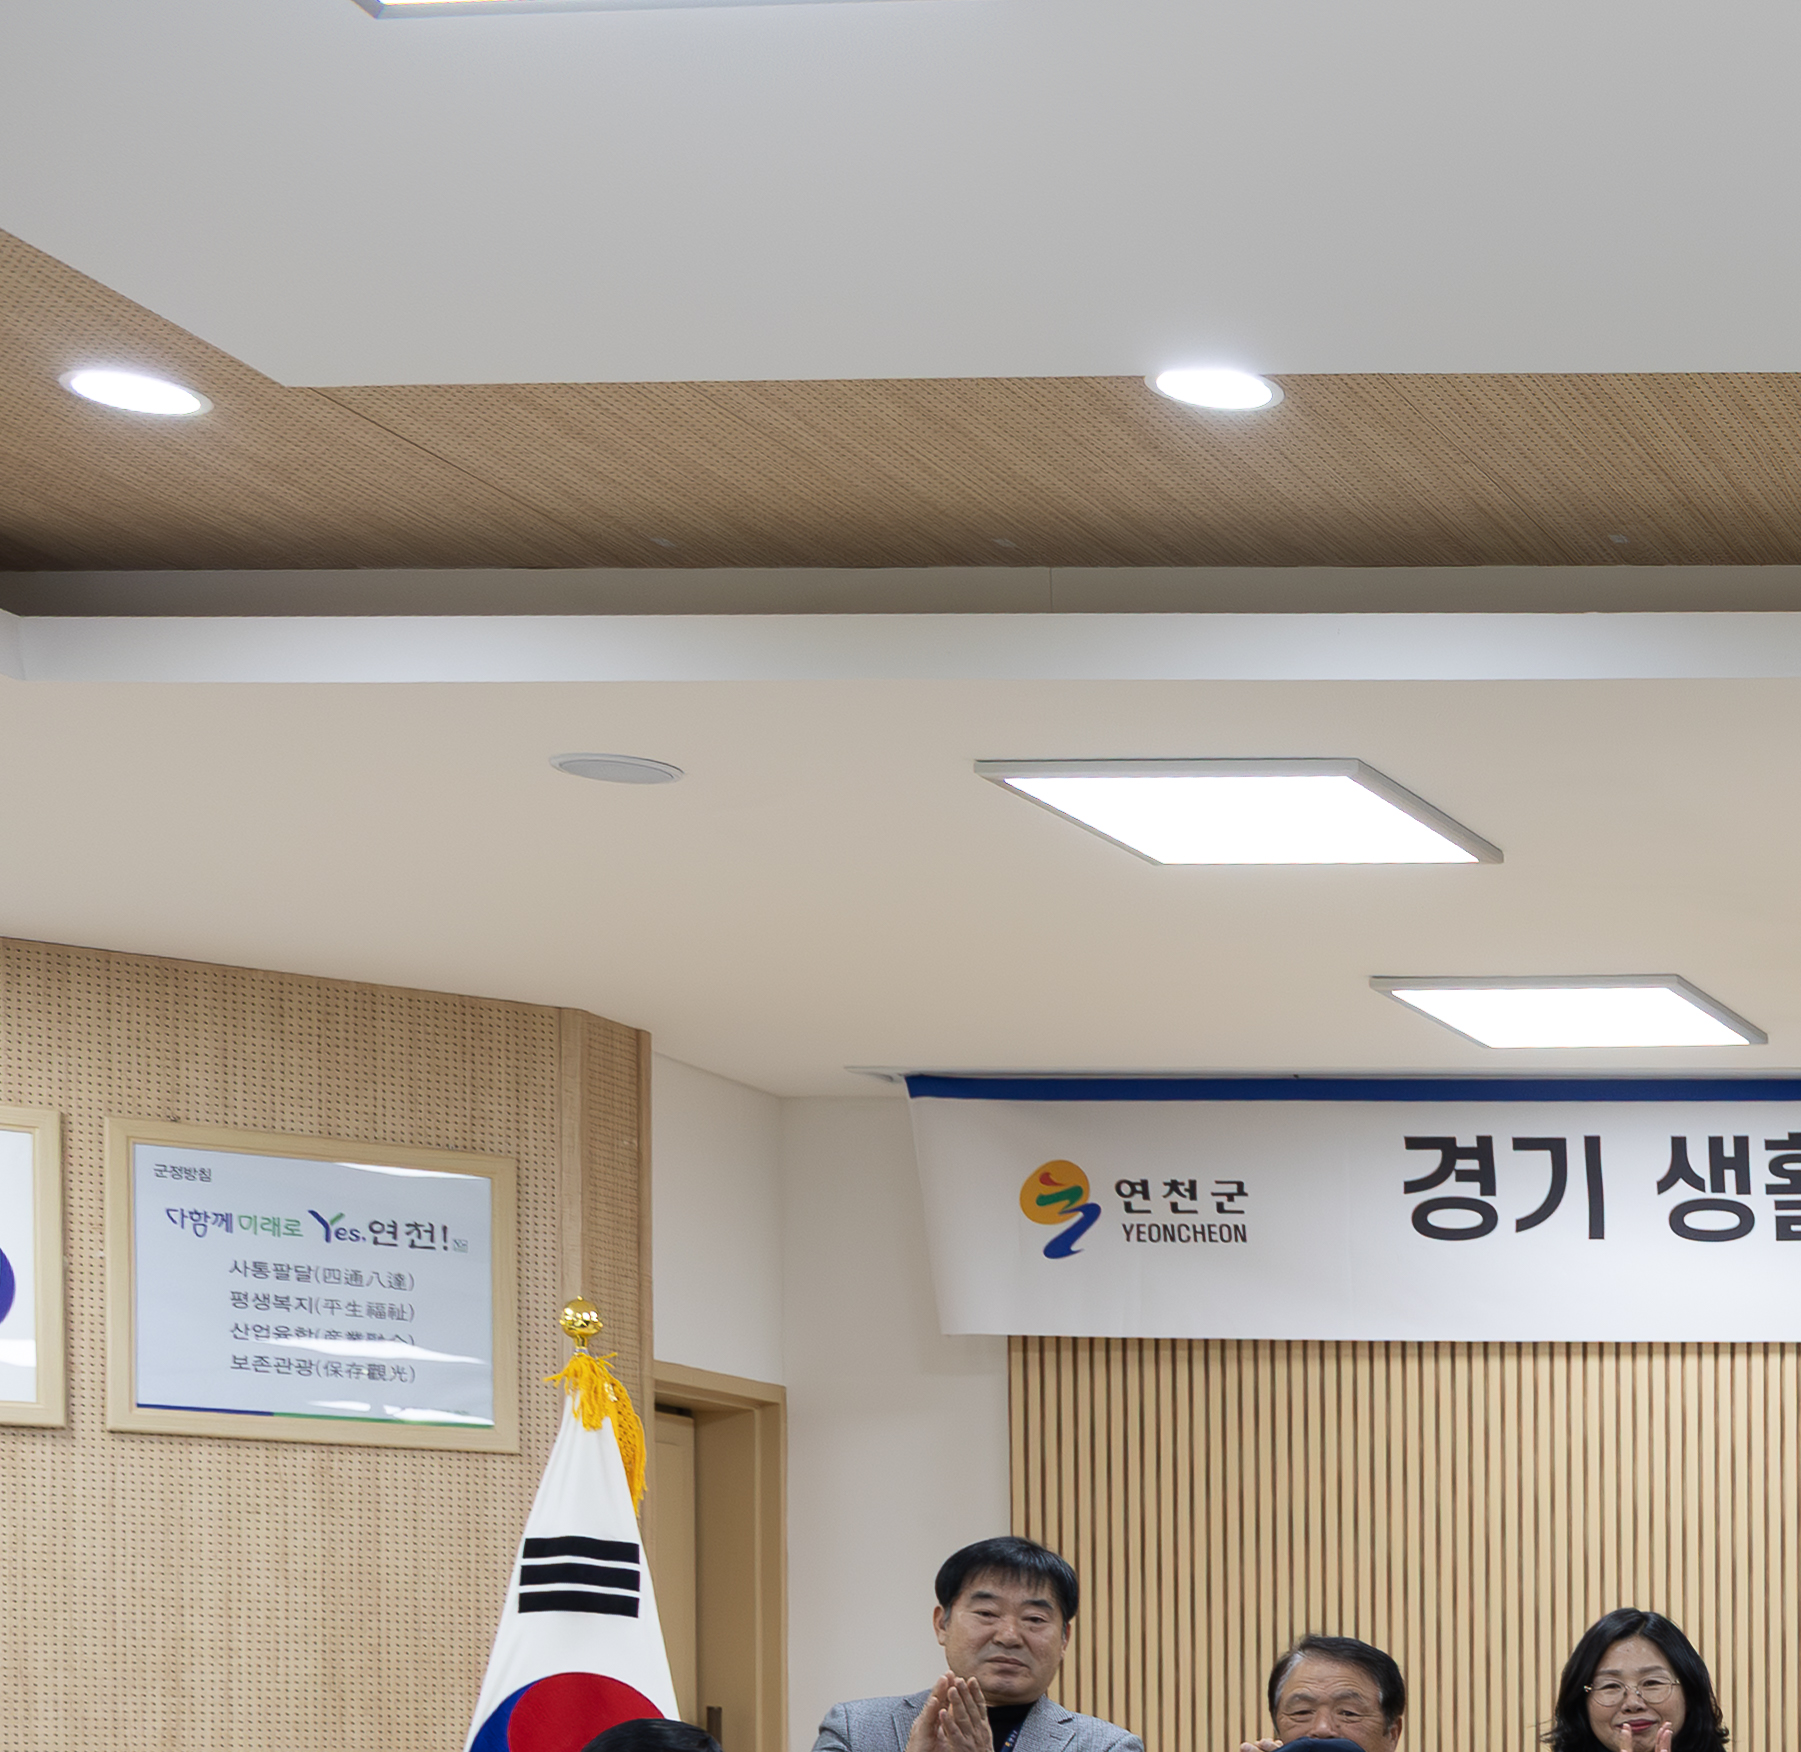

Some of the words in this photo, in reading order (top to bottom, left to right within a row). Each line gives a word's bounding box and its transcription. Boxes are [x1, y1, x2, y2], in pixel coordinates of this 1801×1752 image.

[153, 1164, 212, 1182] 군정방침
[1403, 1135, 1606, 1242] 경기
[1114, 1176, 1249, 1213] 연천군
[165, 1207, 234, 1238] 다함께
[238, 1213, 304, 1238] 미래로
[1122, 1222, 1247, 1245] YEONCHEON
[229, 1260, 415, 1291] 사통팔달(四通八達)
